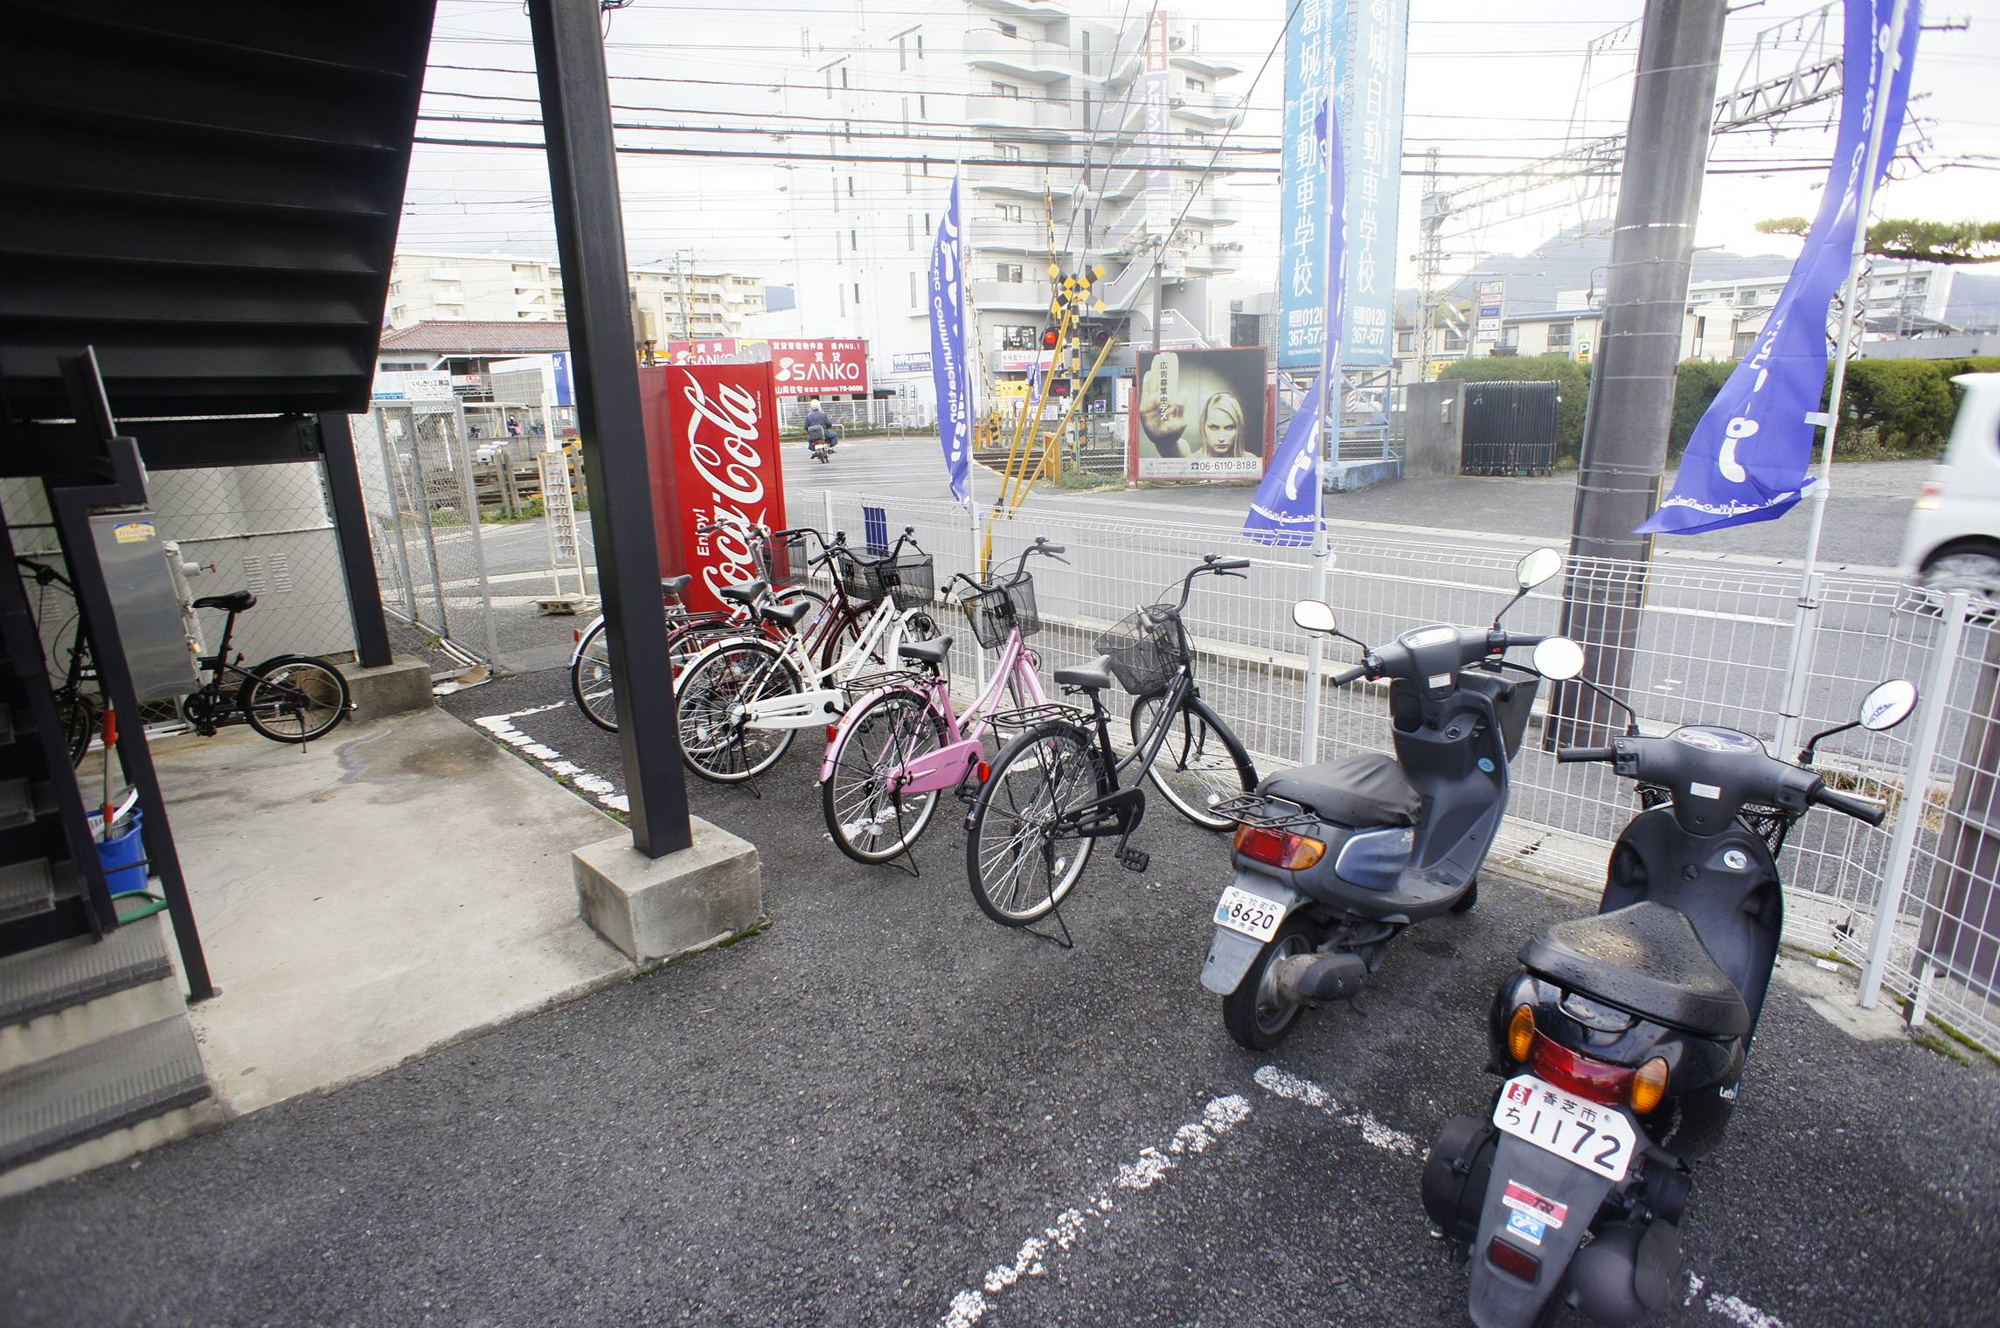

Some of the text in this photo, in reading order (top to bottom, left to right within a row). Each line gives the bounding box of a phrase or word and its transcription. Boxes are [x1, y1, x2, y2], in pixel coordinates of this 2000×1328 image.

[1365, 307, 1386, 327] 0120
[1351, 327, 1385, 345] 367-577
[793, 363, 860, 381] SANKO
[1159, 362, 1168, 420] 広告募集中デス
[1200, 461, 1257, 471] 06-6110-8188
[682, 369, 767, 617] Coca-Cola
[1231, 903, 1275, 930] 8620
[1542, 1090, 1598, 1123] 香芝市
[1505, 1106, 1622, 1171] ち 1172
